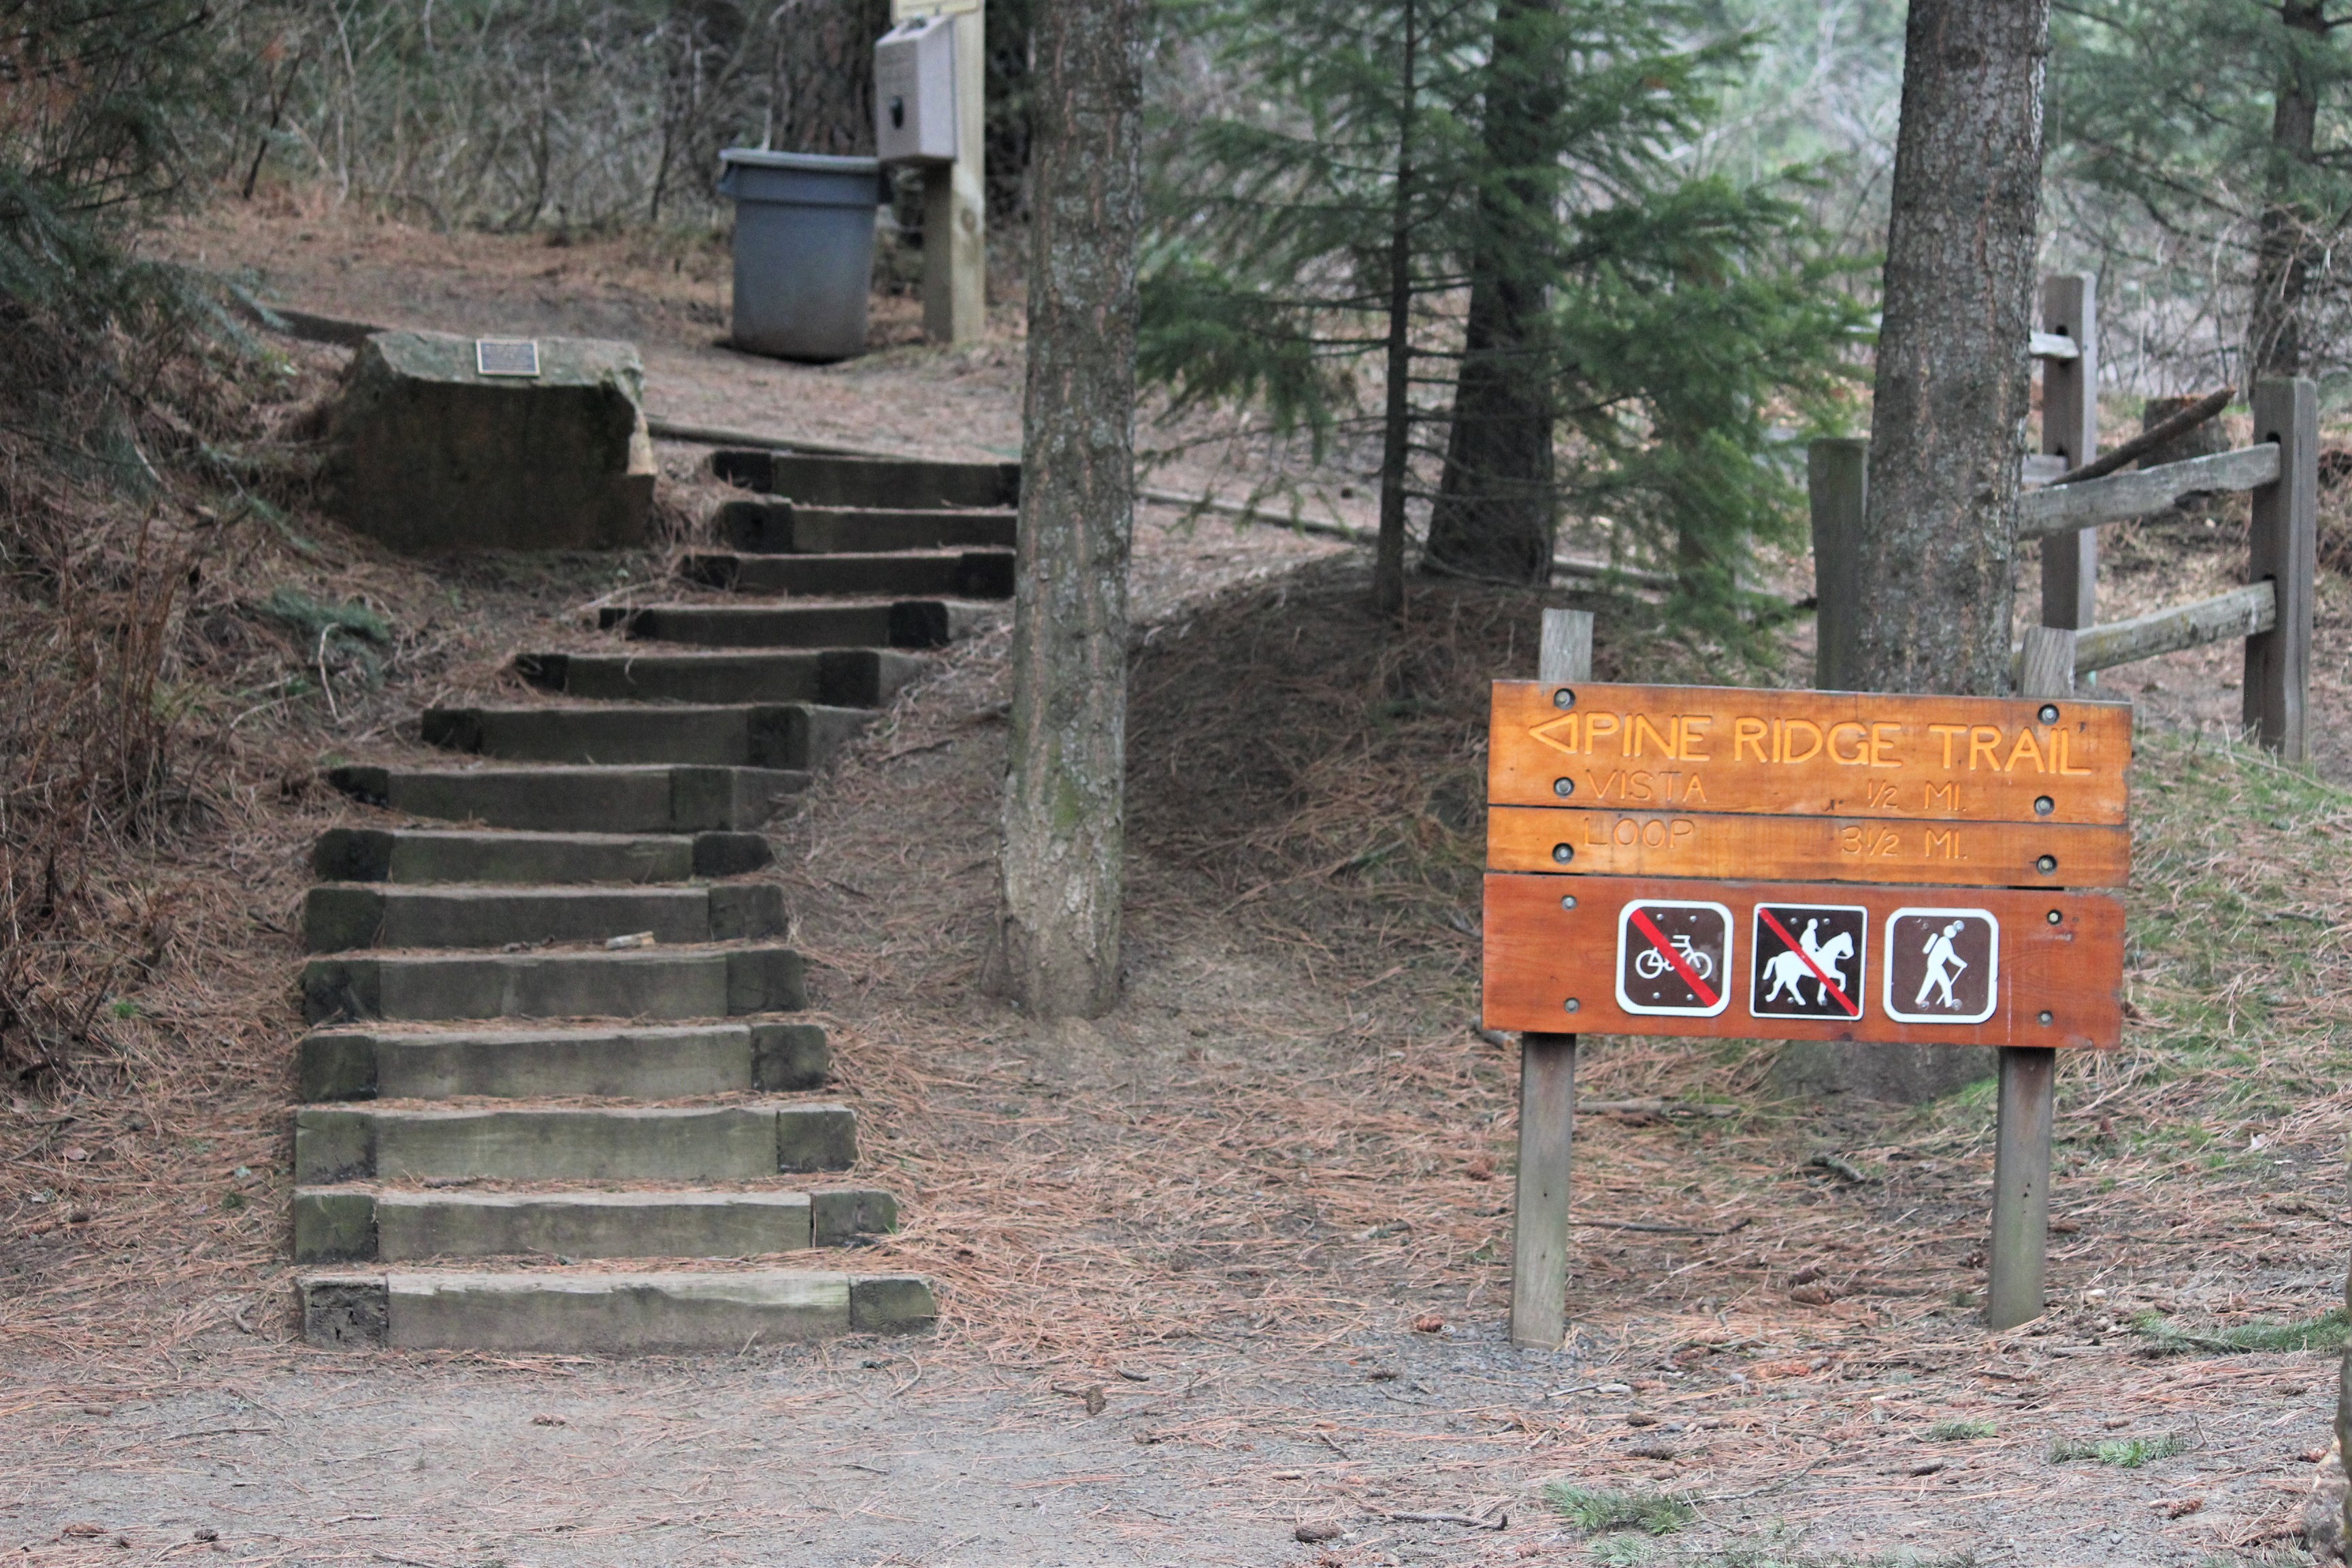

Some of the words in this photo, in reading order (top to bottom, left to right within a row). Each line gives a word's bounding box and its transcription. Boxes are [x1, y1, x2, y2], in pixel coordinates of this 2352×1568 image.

[1584, 711, 1712, 762] PINE
[1734, 715, 1903, 768] RIDGE
[1928, 723, 2092, 775] TRAIL
[1584, 769, 1708, 802] VISTA
[1924, 780, 1967, 812] MI.
[1584, 817, 1695, 849] LOOP
[1924, 828, 1968, 860] MI.
